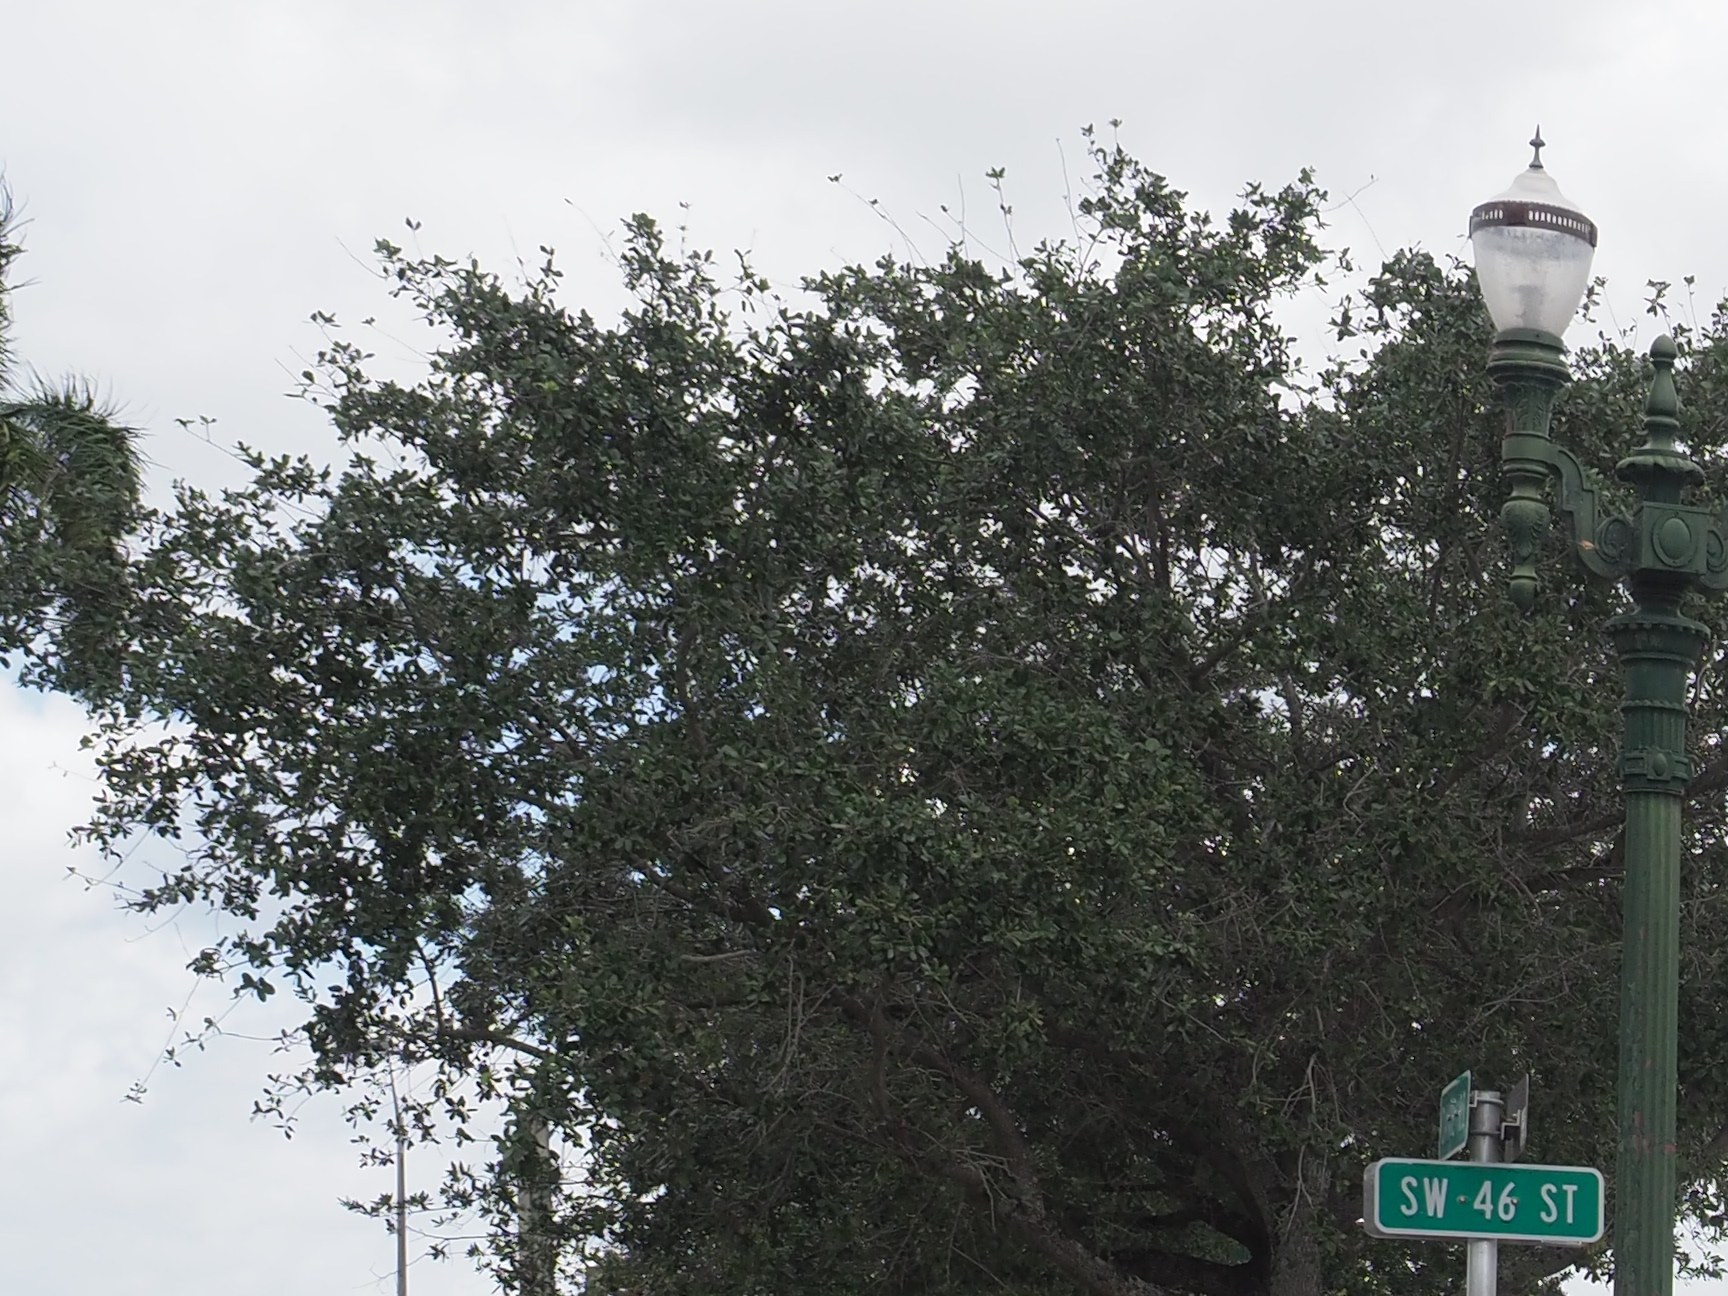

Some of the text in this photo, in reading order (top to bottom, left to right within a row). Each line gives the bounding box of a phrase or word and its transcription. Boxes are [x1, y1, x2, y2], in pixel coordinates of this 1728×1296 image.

[1400, 1176, 1579, 1225] SW 46 ST
